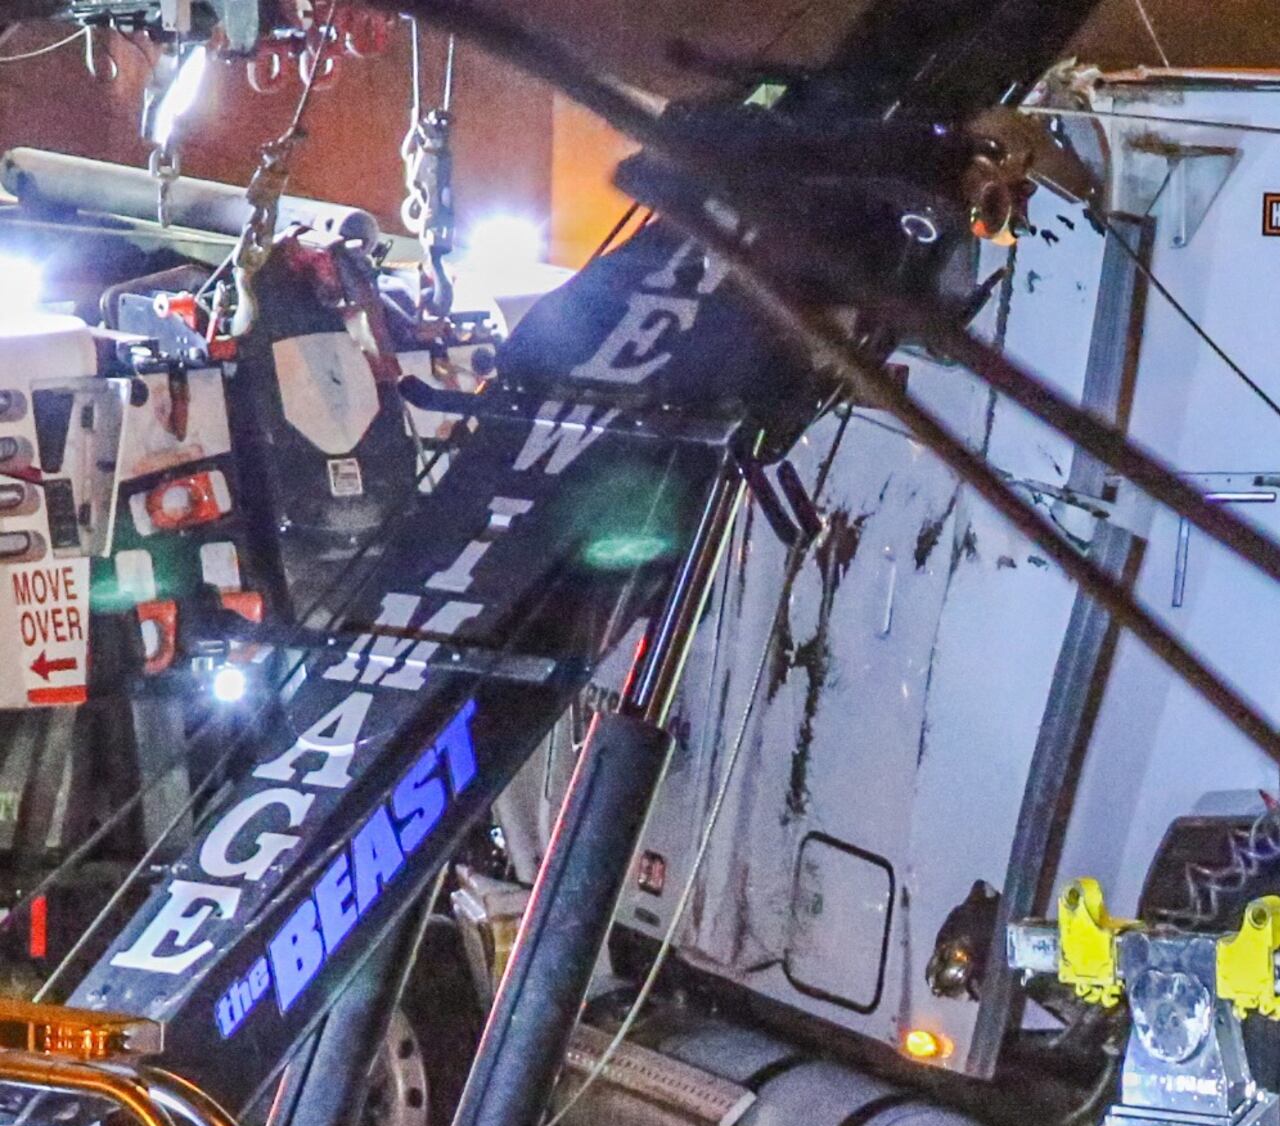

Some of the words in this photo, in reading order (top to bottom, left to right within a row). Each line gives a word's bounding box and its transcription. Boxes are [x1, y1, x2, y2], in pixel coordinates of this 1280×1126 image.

[12, 566, 78, 605] MOVE
[20, 606, 83, 646] OVER
[214, 953, 271, 1040] the
[266, 697, 479, 1017] BEAST
